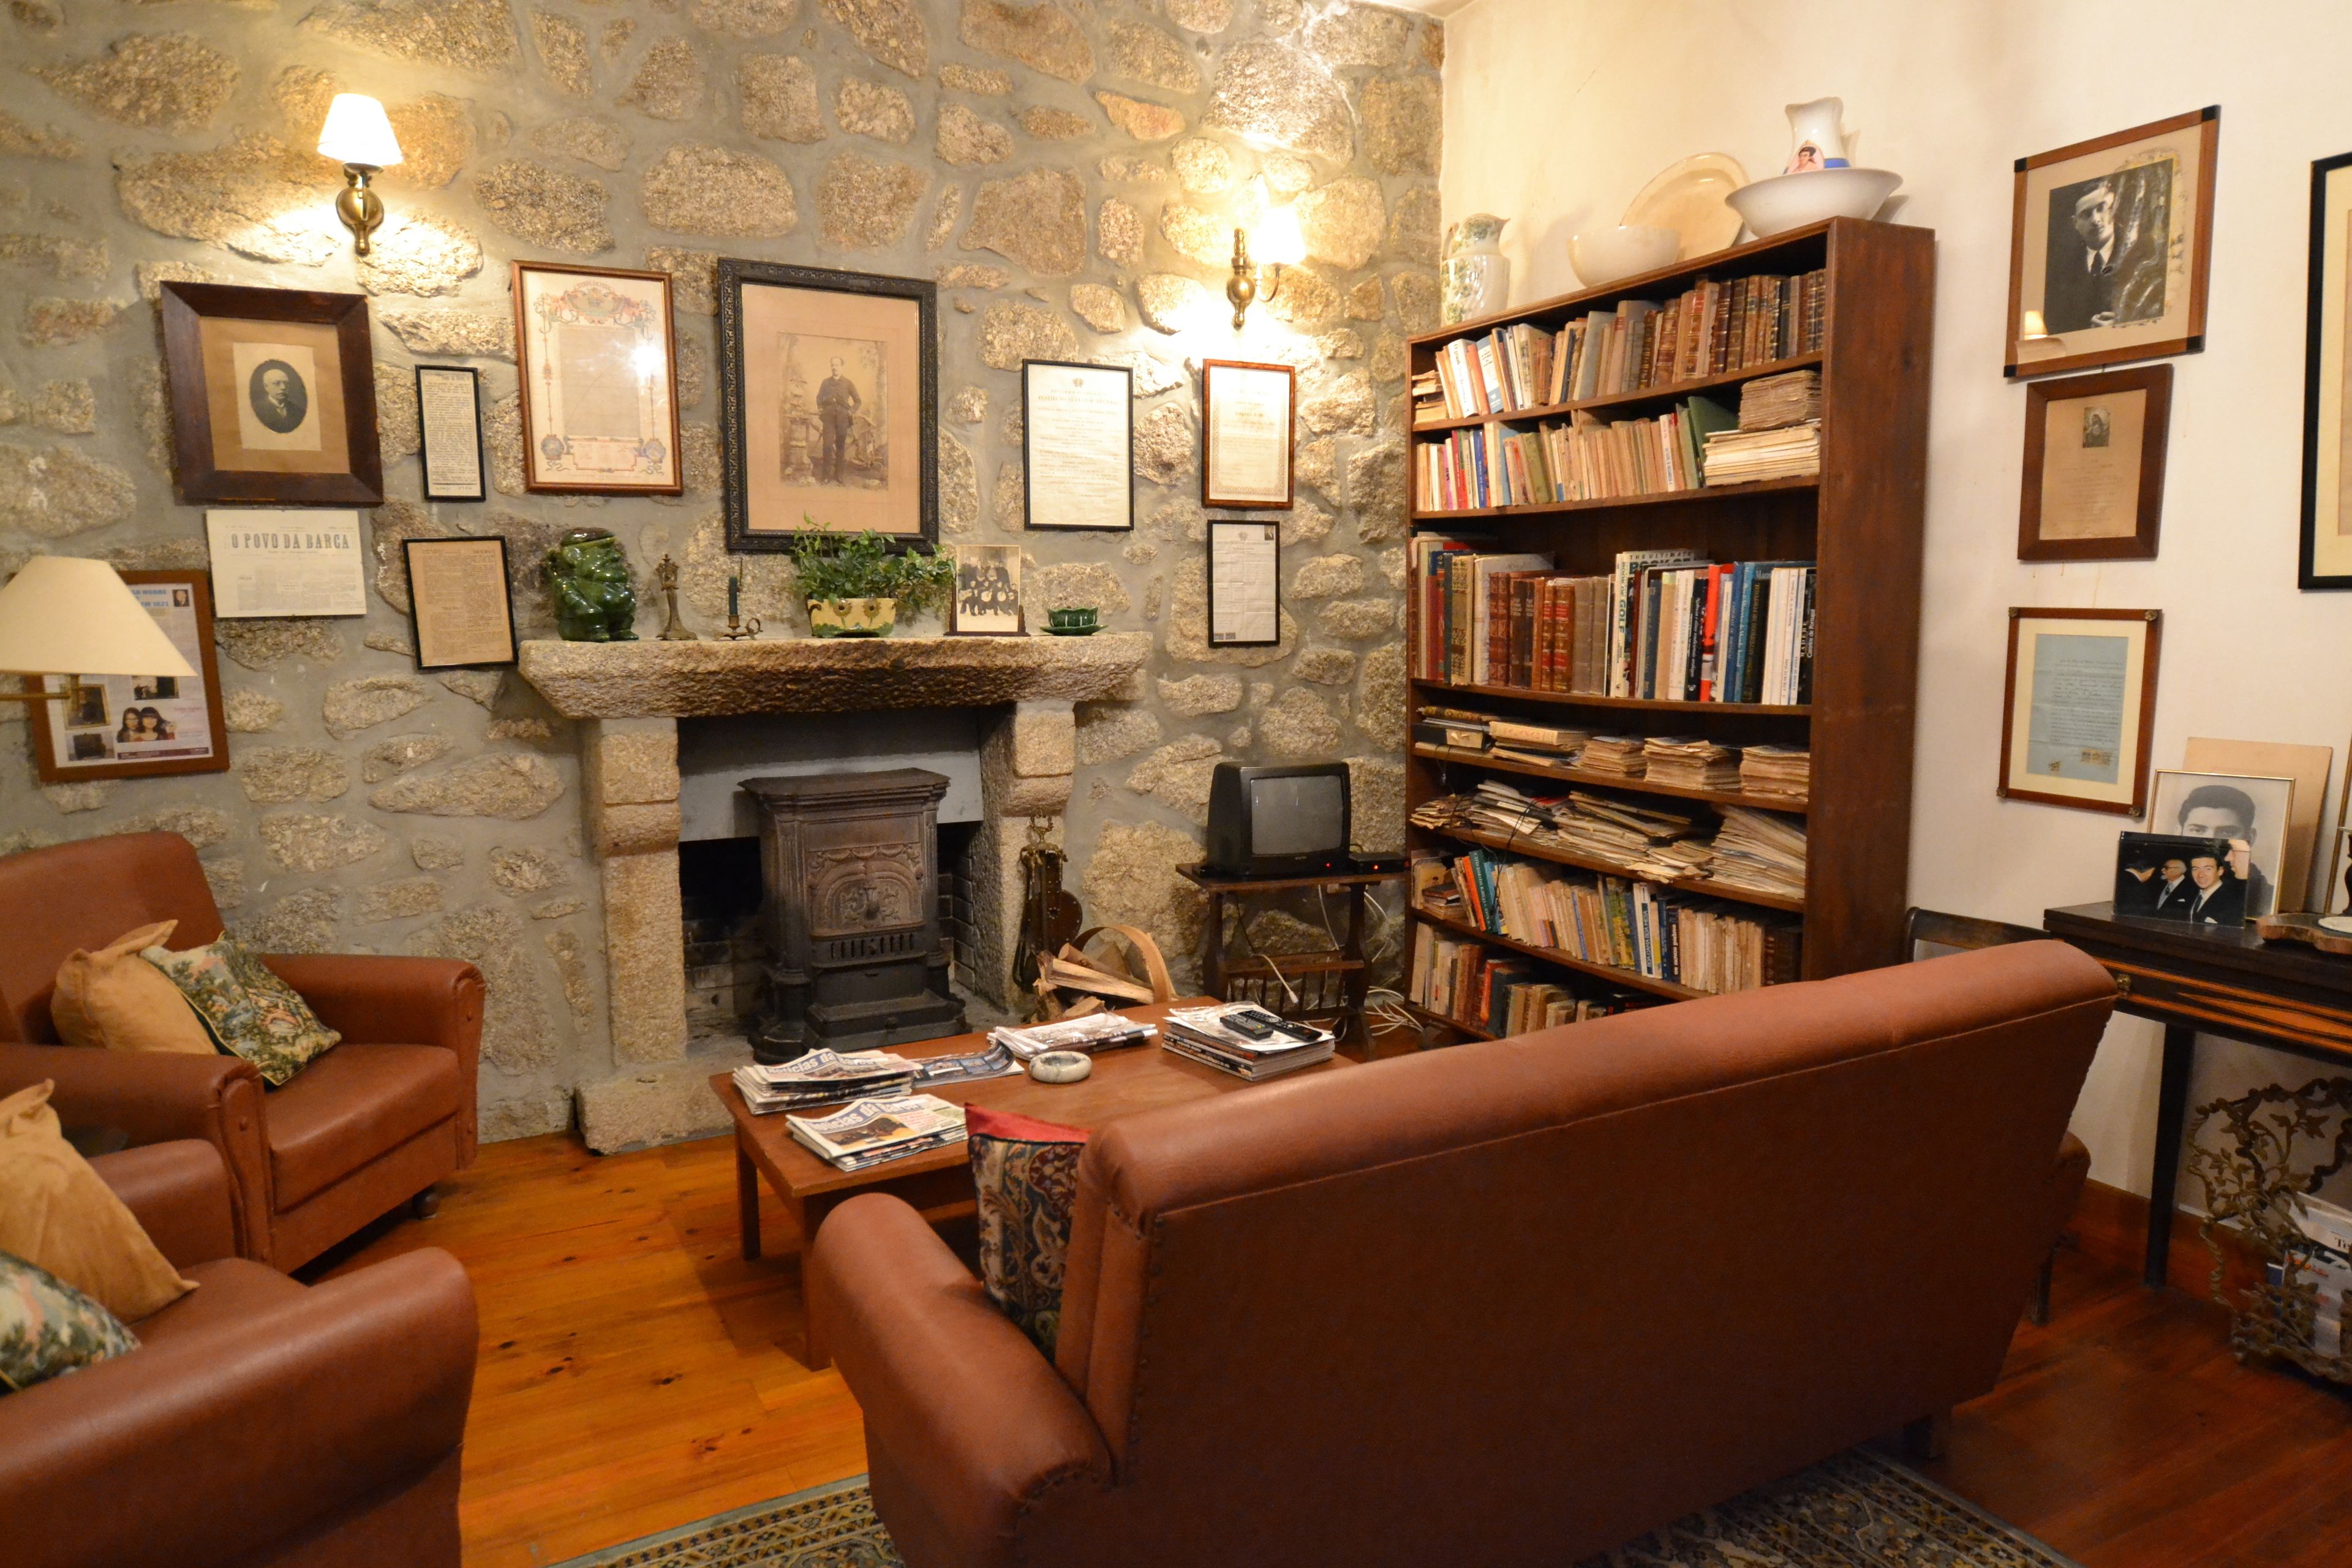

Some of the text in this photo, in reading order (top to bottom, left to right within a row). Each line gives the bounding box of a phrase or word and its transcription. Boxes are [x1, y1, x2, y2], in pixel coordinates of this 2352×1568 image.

[232, 533, 350, 549] O POVO DA BARCA
[1618, 599, 1626, 633] GOLF
[821, 1052, 837, 1063] da
[859, 1101, 878, 1116] da
